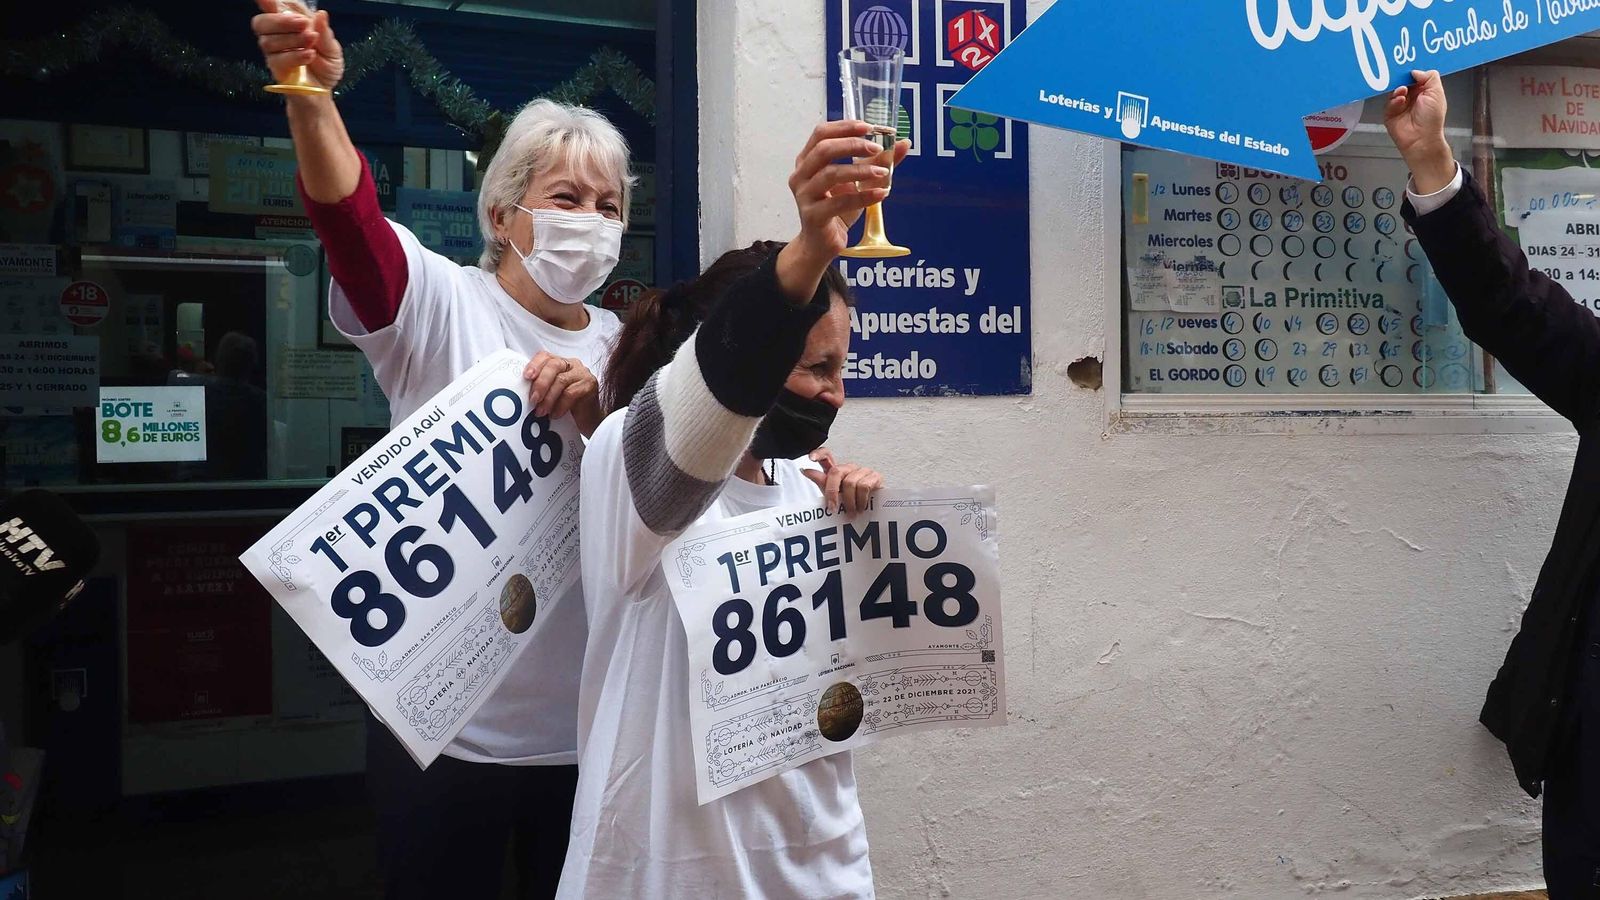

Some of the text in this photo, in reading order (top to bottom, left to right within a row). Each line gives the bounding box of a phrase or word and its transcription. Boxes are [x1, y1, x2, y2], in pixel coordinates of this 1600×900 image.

[1393, 27, 1416, 64] el
[1423, 7, 1497, 54] Gordo
[1502, 0, 1528, 33] de
[1566, 102, 1584, 116] DE
[1039, 89, 1290, 157] Loterías y Apuestas del Estado
[1542, 114, 1600, 135] NAVIDA
[1172, 184, 1211, 196] Lunes
[1164, 208, 1212, 222] Martes
[1148, 234, 1213, 248] Miercoles
[1528, 246, 1557, 256] DIAS
[1560, 246, 1575, 257] 24
[1587, 247, 1600, 258] 31
[839, 259, 980, 296] Loterías y
[1566, 271, 1574, 280] a
[1250, 286, 1384, 309] La Primitiva
[848, 306, 1021, 340] Apuestas del
[1167, 341, 1219, 356] Sabado
[841, 351, 937, 379] Estado
[1150, 368, 1220, 381] EL GORDO
[102, 402, 153, 418] BOTE
[142, 422, 200, 432] MILLONES
[143, 432, 200, 442] DE EUROS
[351, 405, 446, 486] VENDIDO AQUÍ
[342, 388, 523, 550] PREMIO
[776, 506, 833, 528] VENDIDO
[331, 410, 563, 648] 86148
[755, 519, 948, 586] PREMIO
[712, 562, 980, 676] 86148
[424, 680, 455, 711] LOTERÍA
[466, 636, 494, 668] NAVIDAD
[894, 693, 906, 701] DE
[908, 689, 954, 699] DICIEMBRE
[723, 740, 754, 756] LOTERÍA
[770, 722, 803, 739] NAVIDAD
